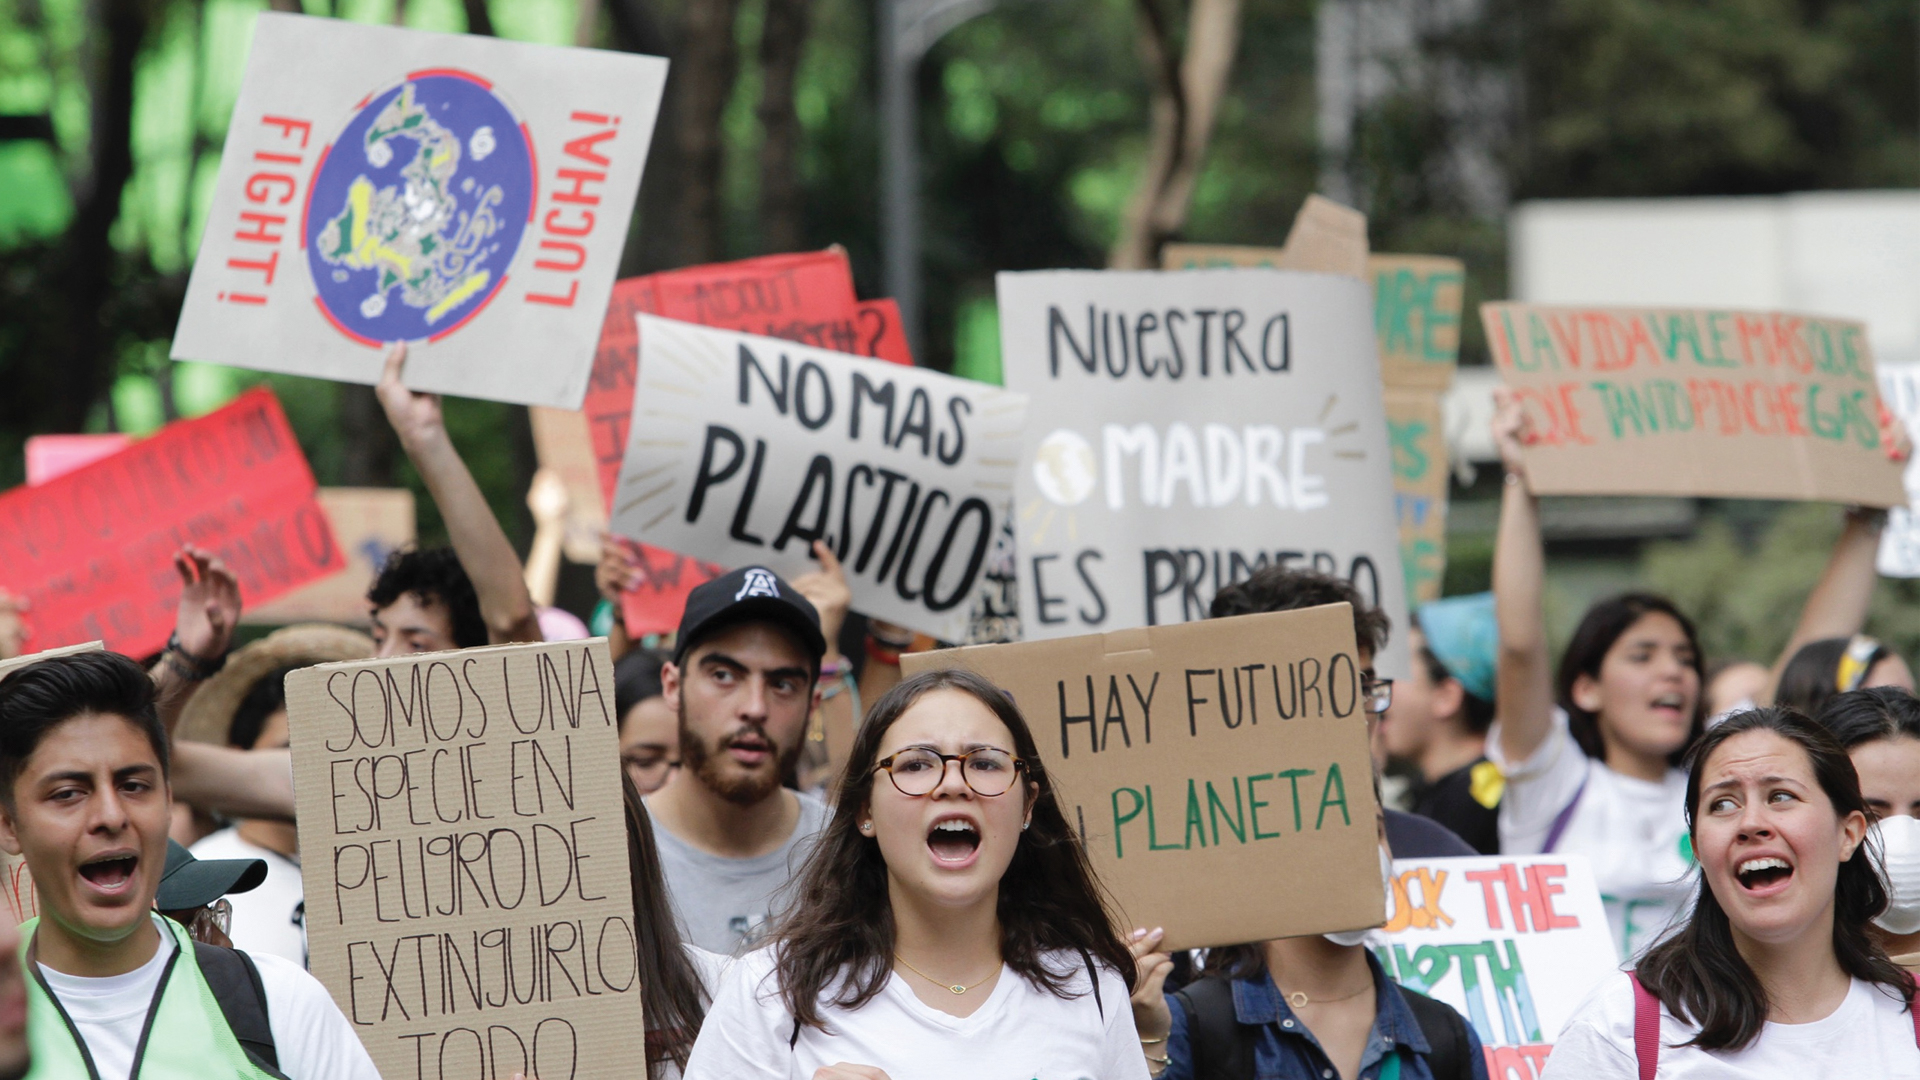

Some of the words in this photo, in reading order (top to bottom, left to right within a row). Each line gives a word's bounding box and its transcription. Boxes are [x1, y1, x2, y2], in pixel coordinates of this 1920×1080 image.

[217, 113, 313, 307] FIGHT!
[524, 109, 622, 308] LUCHA!
[1502, 311, 1561, 373] LA
[1550, 310, 1663, 372] VIDA
[1647, 309, 1741, 369] VALE
[1733, 311, 1814, 375] MAS
[737, 341, 834, 431] NO
[850, 370, 973, 466] MAS
[1590, 376, 1694, 440] TANTO
[1807, 384, 1880, 450] GAS
[1102, 422, 1329, 511] MADRE
[685, 424, 992, 611] PLASTICO
[735, 568, 781, 601] A
[1032, 549, 1108, 626] ES
[325, 657, 488, 752] SOMOS
[503, 646, 611, 735] UNA
[1057, 671, 1161, 759] HAY
[1185, 652, 1357, 737] FUTURO
[330, 741, 496, 835] ESPECIE
[510, 734, 575, 817] EN
[1111, 762, 1352, 859] PLANETA
[1465, 862, 1581, 933] THE
[398, 1017, 578, 1080] TODO
